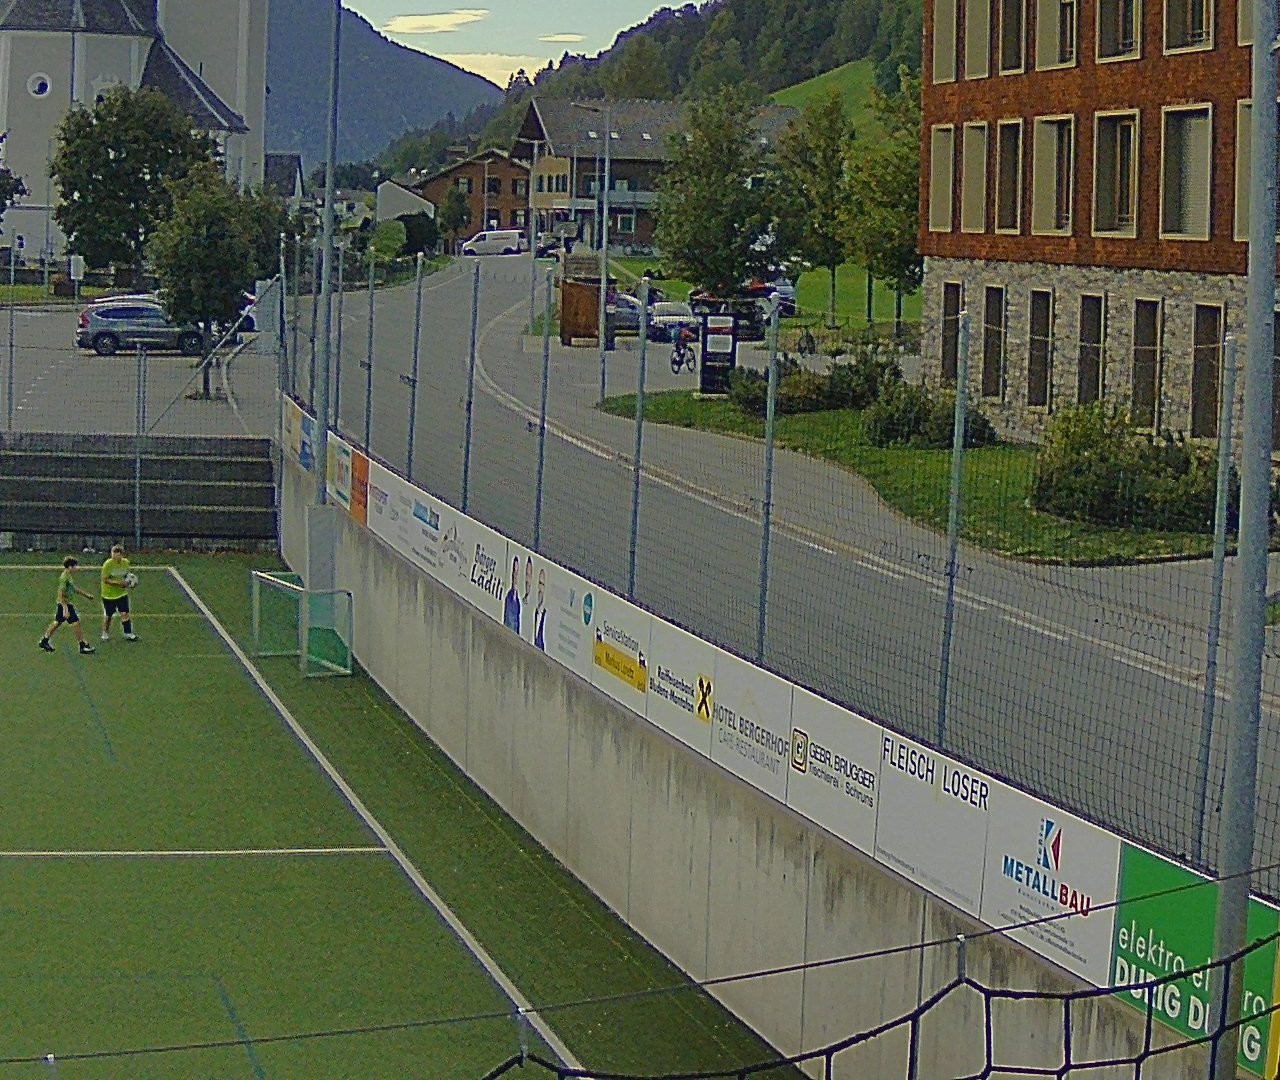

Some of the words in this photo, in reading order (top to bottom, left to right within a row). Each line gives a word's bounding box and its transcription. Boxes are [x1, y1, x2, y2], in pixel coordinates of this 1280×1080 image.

[712, 702, 737, 731] HOTEL
[739, 716, 790, 758] BERGERHOF
[834, 755, 876, 792] BRUGGER
[882, 737, 936, 785] FLEISCH
[942, 765, 989, 812] LOSER
[1002, 855, 1091, 917] METALLBAU
[1119, 919, 1187, 976] elektro
